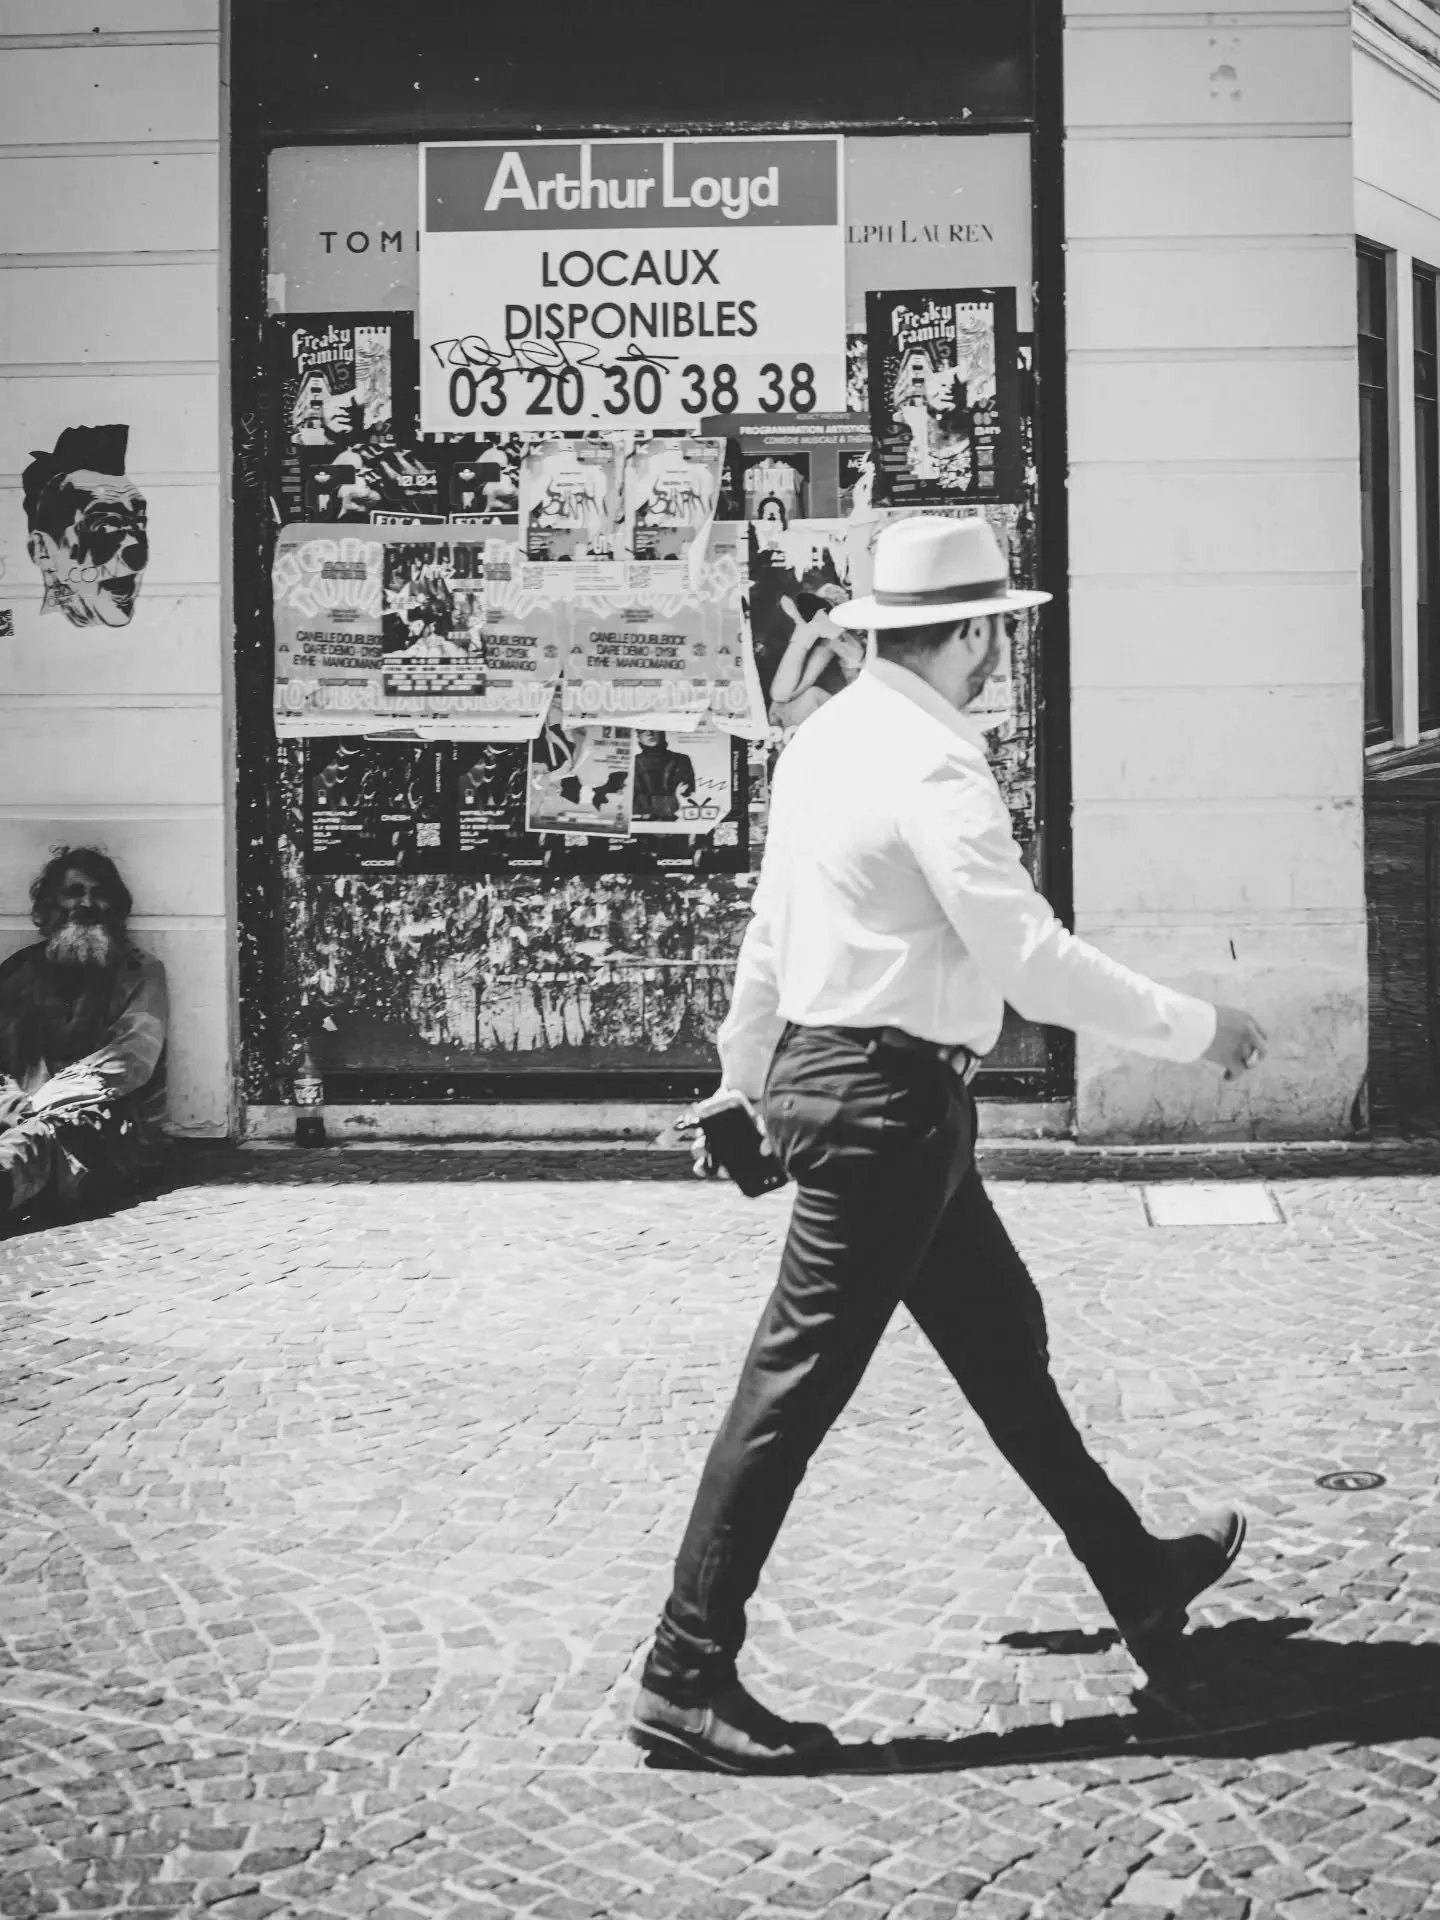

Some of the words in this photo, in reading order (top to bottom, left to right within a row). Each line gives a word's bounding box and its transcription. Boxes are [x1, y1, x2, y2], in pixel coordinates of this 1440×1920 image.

[483, 143, 655, 211] Arthur
[663, 143, 779, 219] Loyd
[319, 230, 420, 253] TOM
[848, 225, 892, 243] LPH
[541, 249, 719, 288] LOCAUX
[505, 300, 758, 340] DISPONIBLES
[449, 366, 507, 417] 03
[526, 366, 584, 416] 20
[604, 364, 662, 415] 30
[681, 363, 739, 414] 38
[758, 362, 817, 413] 38
